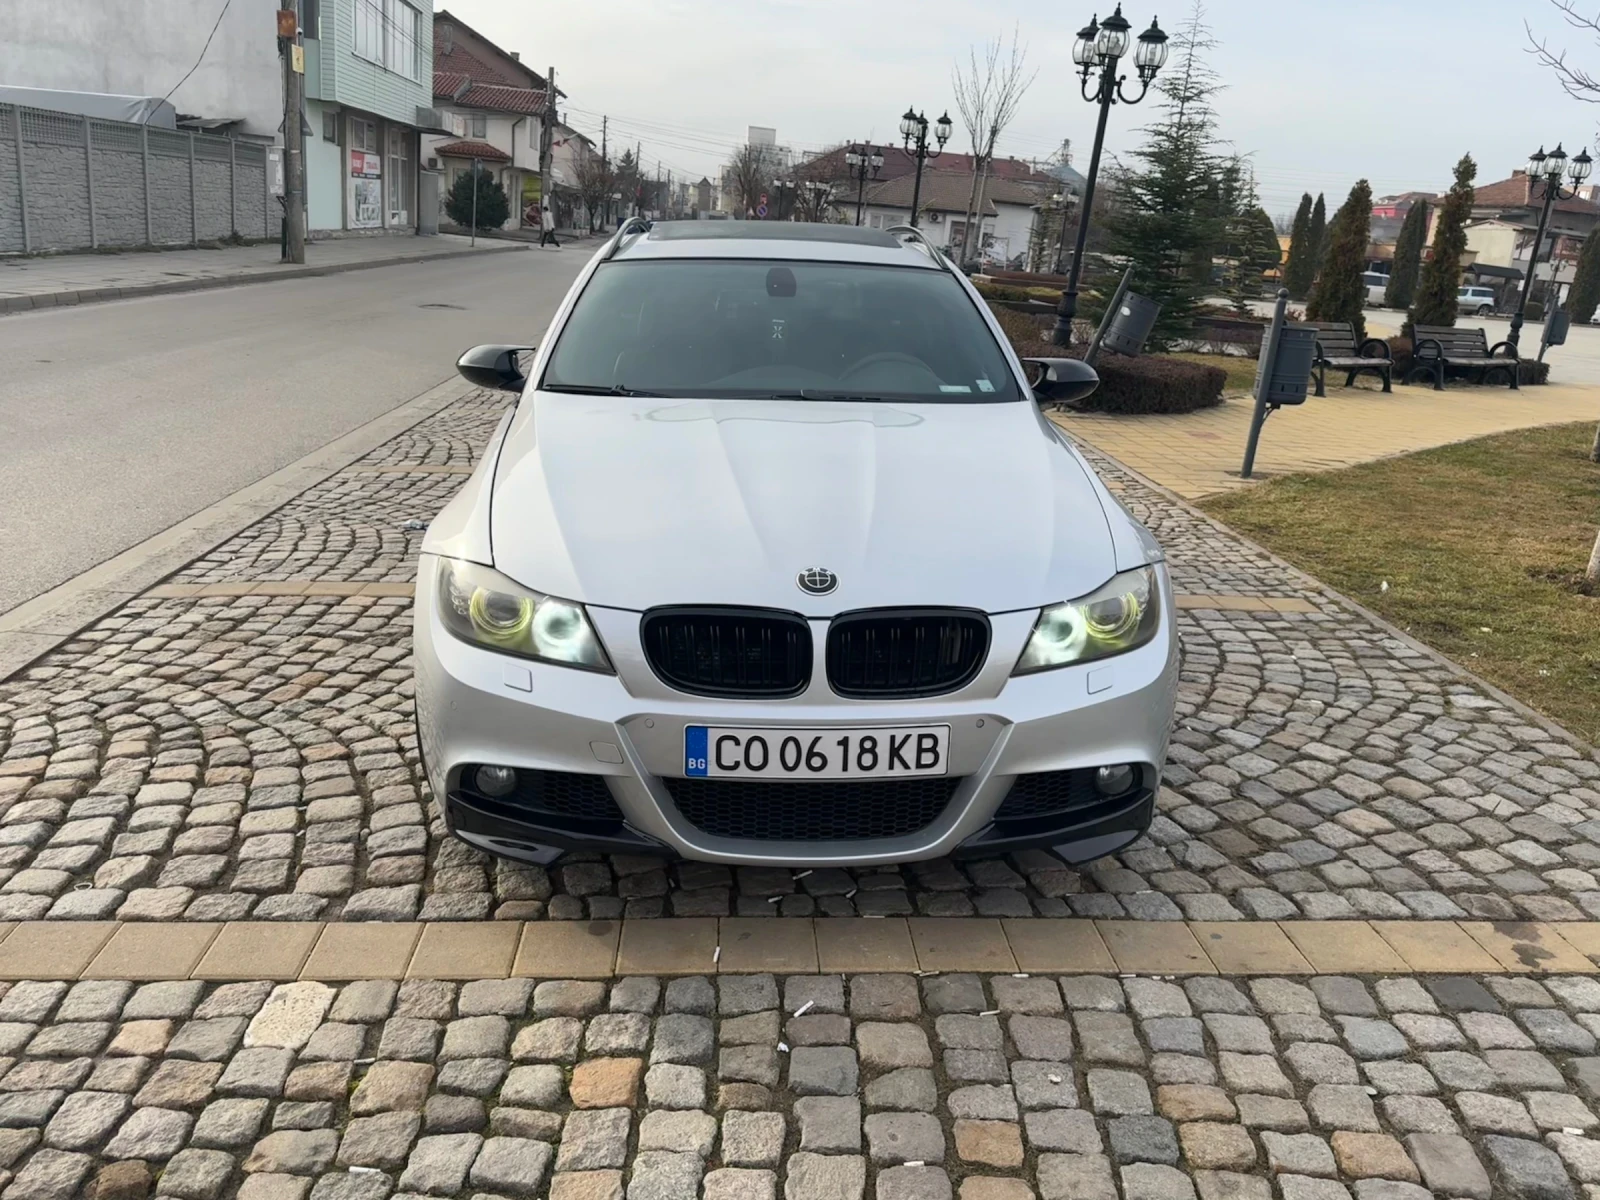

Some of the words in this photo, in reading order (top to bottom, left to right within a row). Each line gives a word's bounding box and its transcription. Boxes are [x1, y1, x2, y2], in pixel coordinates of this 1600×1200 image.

[688, 758, 706, 769] BG
[715, 735, 769, 771] CO
[780, 735, 878, 772] 0618
[888, 733, 940, 770] KB
